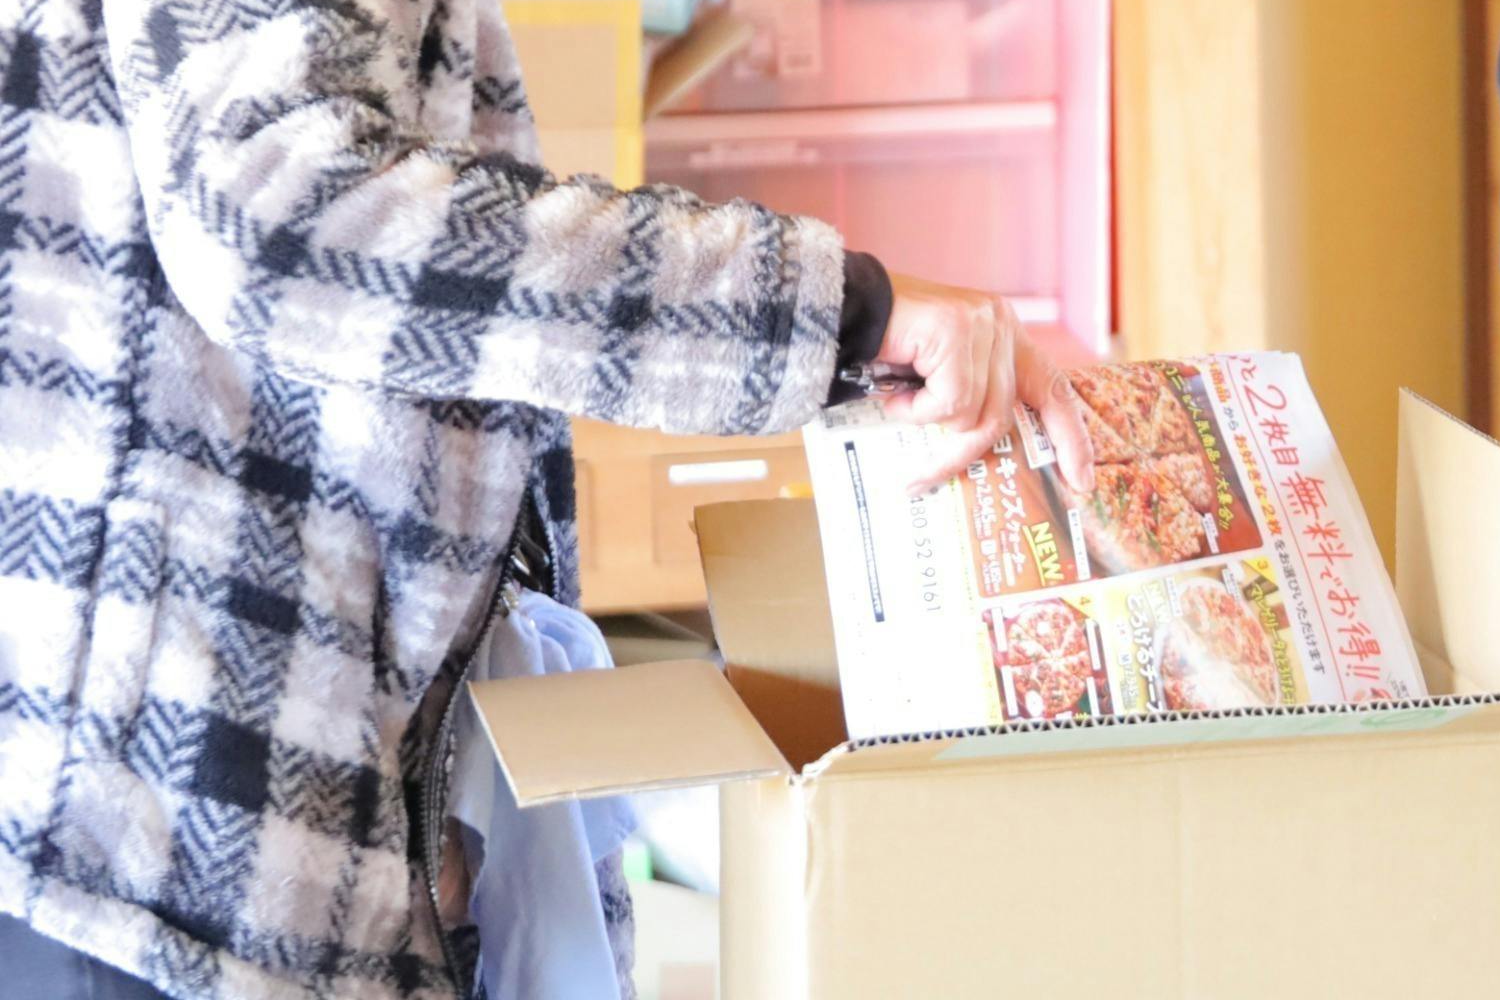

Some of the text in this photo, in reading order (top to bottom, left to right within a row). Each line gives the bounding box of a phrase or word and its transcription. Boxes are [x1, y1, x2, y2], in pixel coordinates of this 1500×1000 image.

[914, 537, 933, 559] 52
[1030, 521, 1065, 582] NEW
[921, 567, 942, 612] 9161
